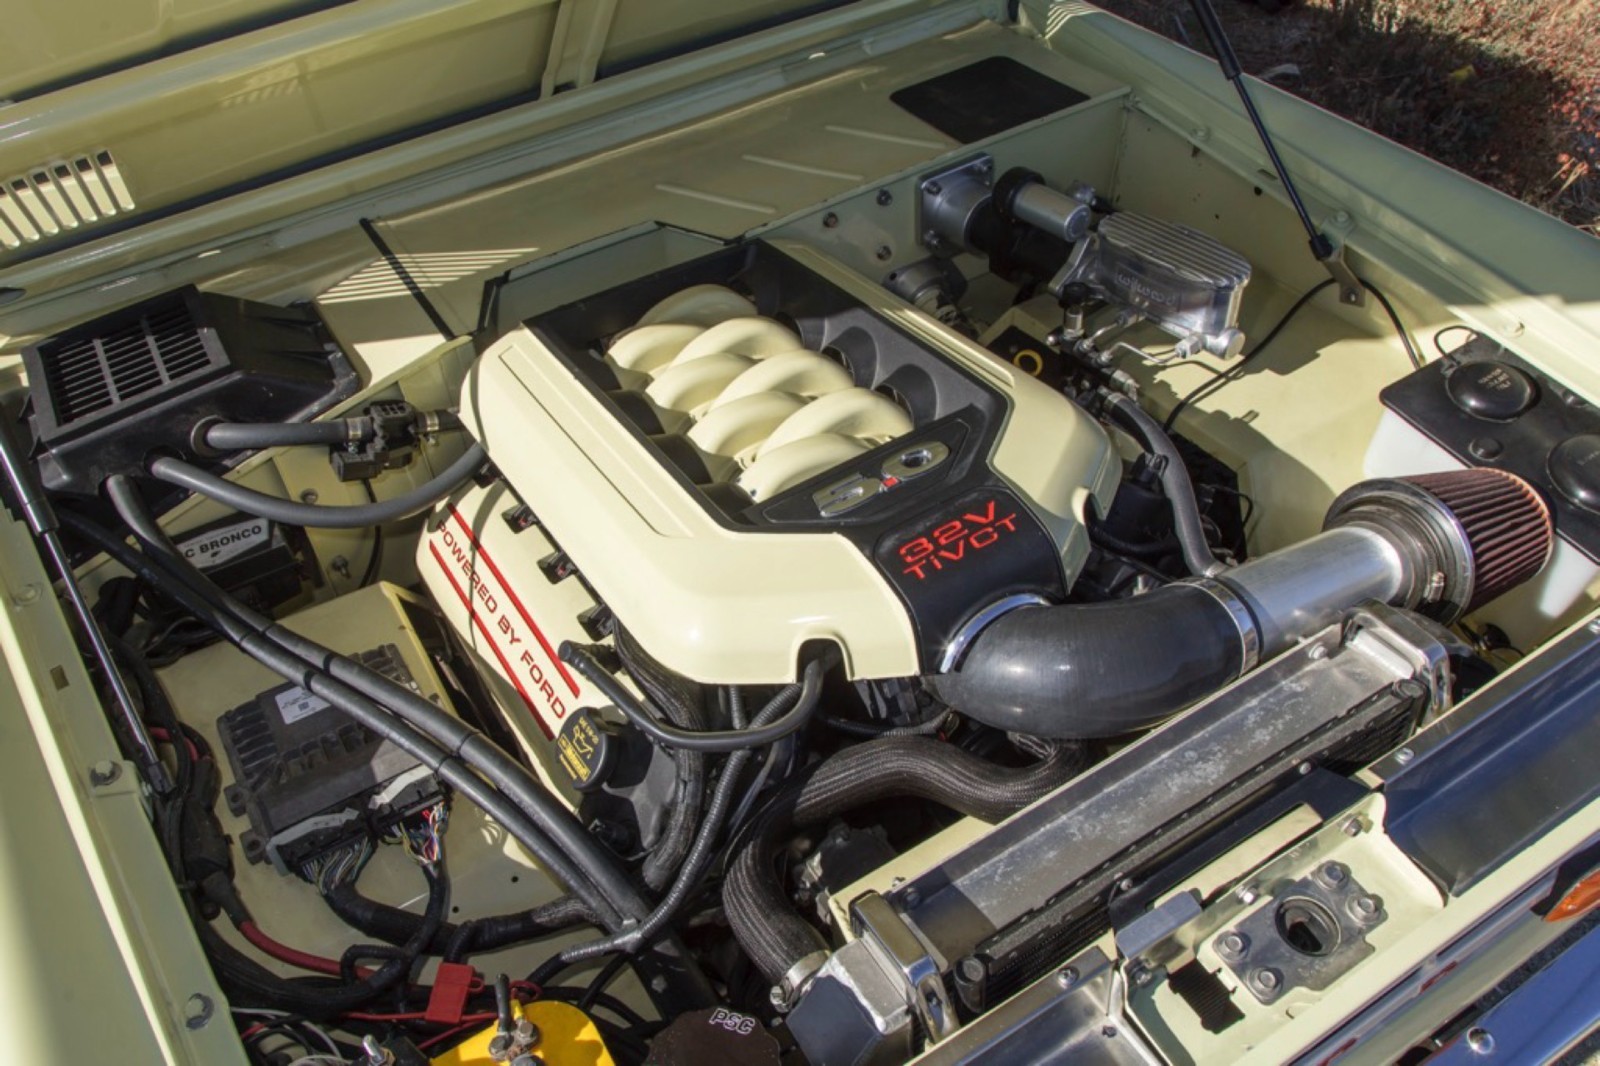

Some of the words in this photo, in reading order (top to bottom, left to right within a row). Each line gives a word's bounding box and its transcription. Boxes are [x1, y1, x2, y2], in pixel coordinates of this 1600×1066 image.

[199, 525, 262, 554] BRONCO
[899, 500, 995, 563] 32V
[903, 513, 1017, 579] TiVCT
[436, 521, 498, 614] POWERED
[497, 614, 522, 645] BY
[520, 650, 567, 719] FORD
[708, 1007, 756, 1036] PSC
